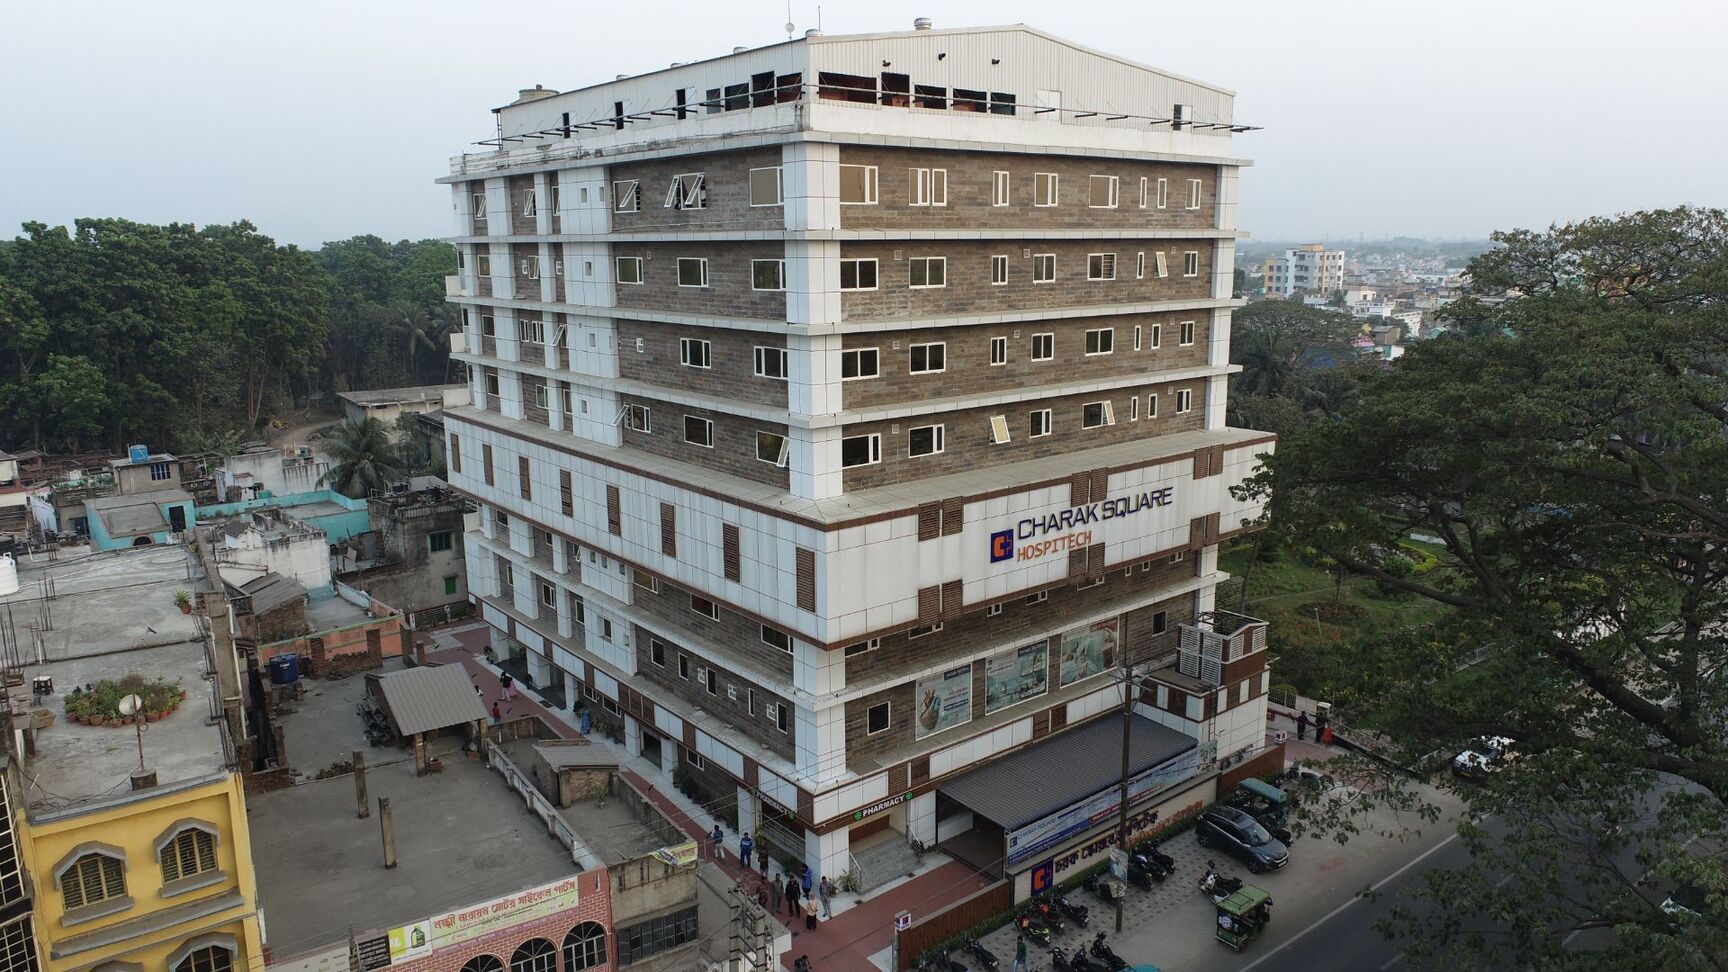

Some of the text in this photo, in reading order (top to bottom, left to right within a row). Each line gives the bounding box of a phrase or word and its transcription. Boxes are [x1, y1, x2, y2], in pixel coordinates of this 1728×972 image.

[1018, 486, 1174, 540] CHARAK SQUARE
[1017, 530, 1092, 562] HOSPITECH
[862, 794, 905, 817] PHARMACY
[491, 898, 516, 913] মোটর
[553, 879, 576, 895] পার্টস
